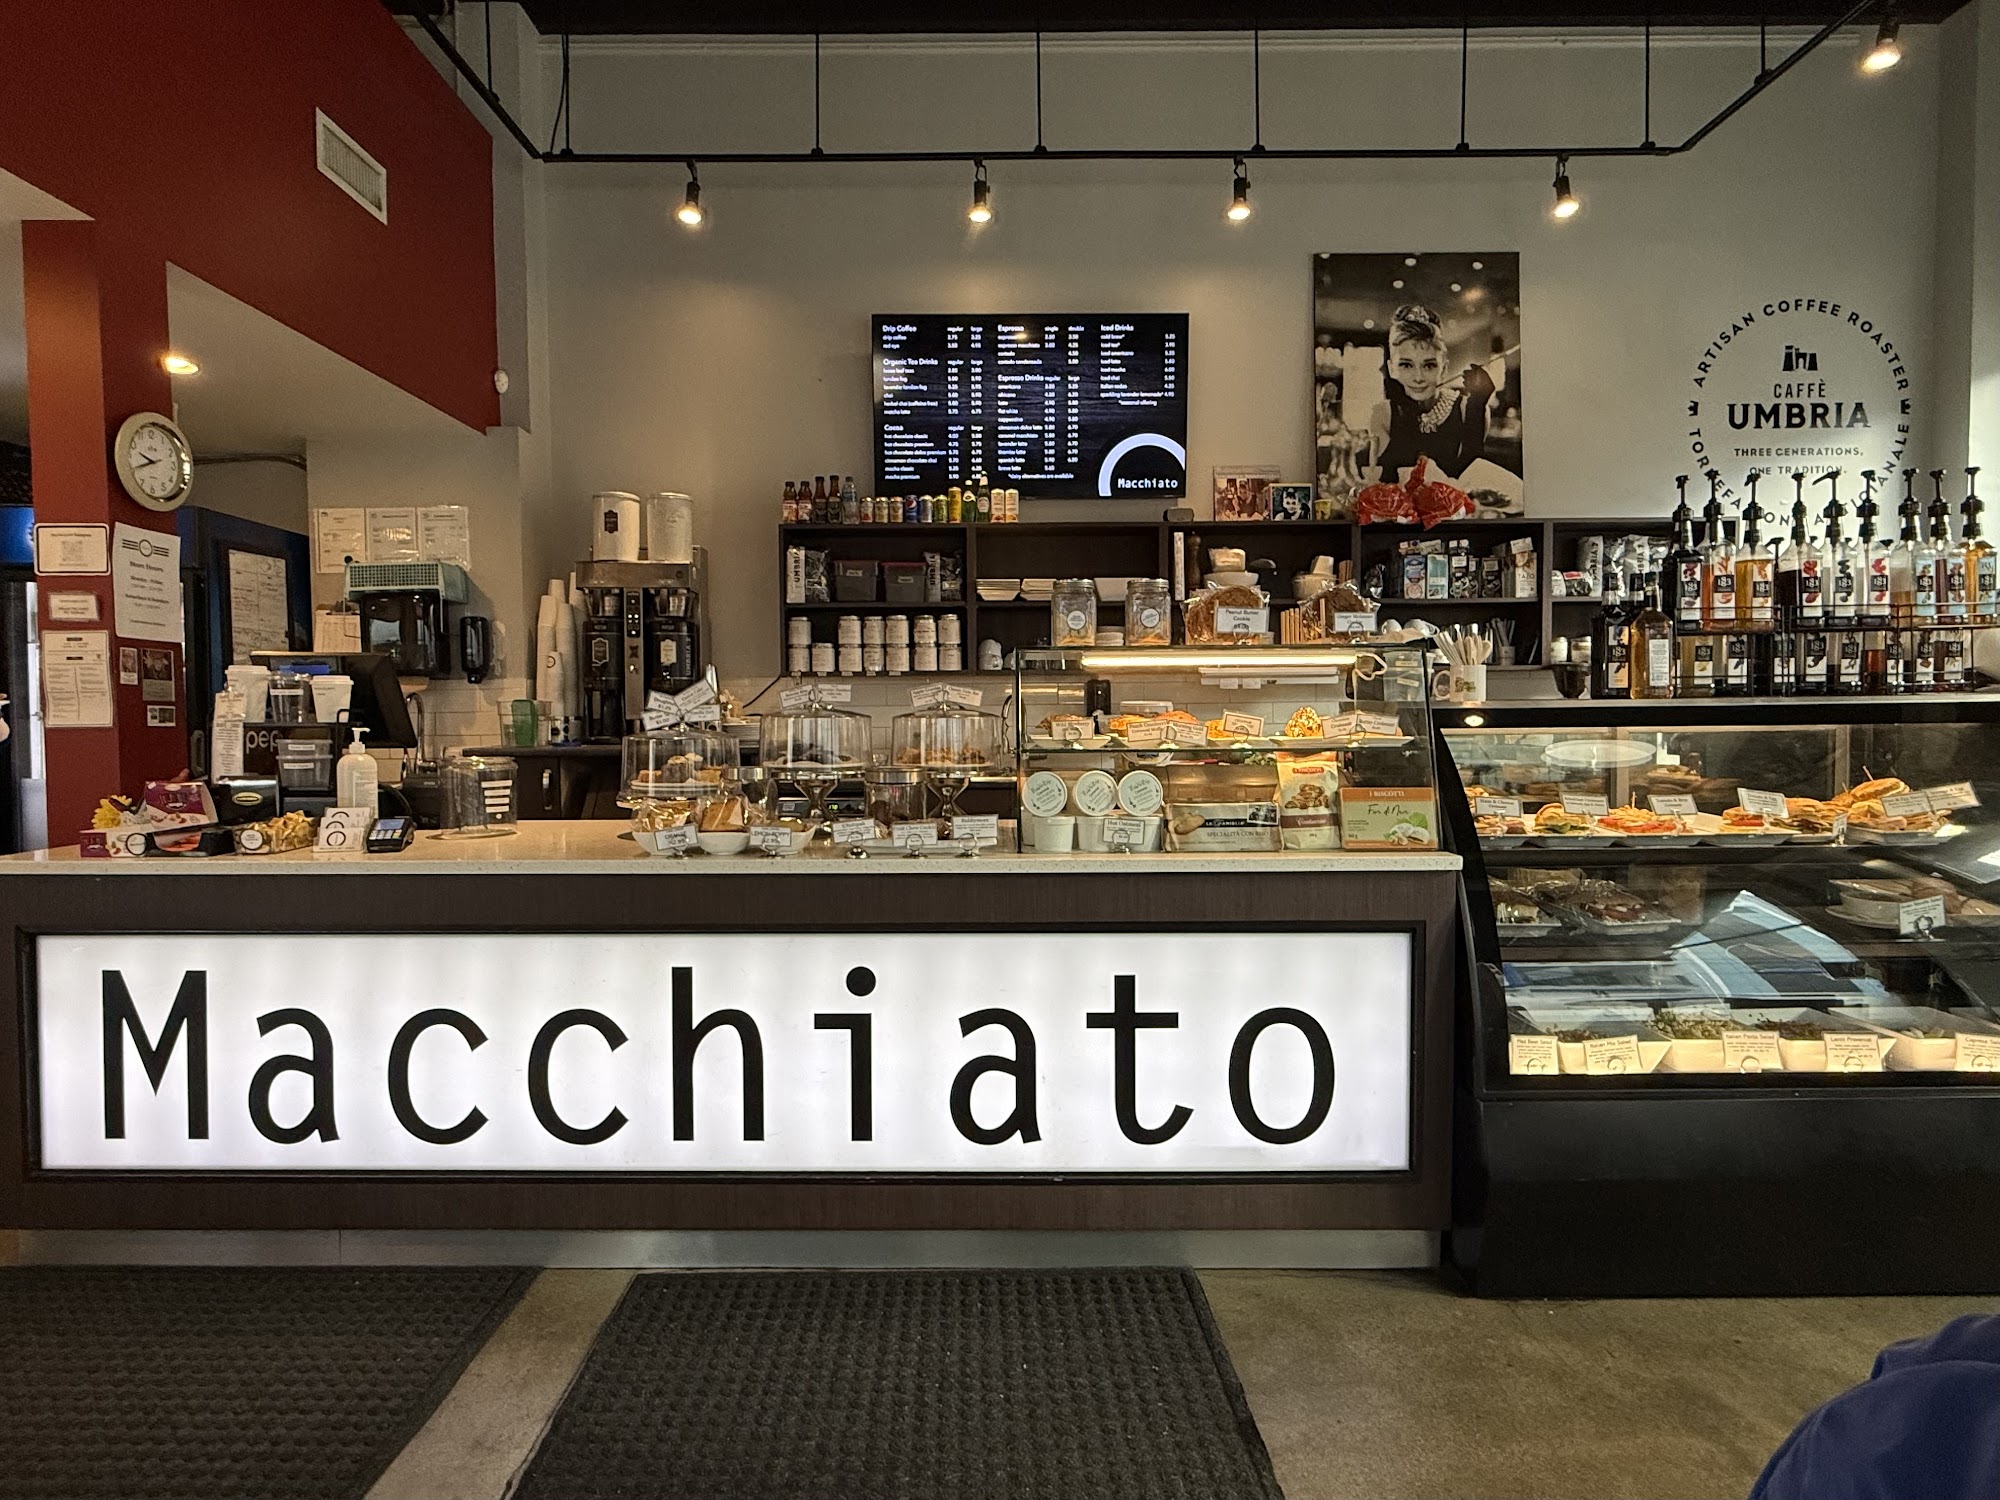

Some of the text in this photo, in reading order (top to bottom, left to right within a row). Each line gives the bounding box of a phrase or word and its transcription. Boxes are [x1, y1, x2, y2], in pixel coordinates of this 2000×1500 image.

[882, 324, 896, 333] Drip
[998, 324, 1024, 333] Espresso
[1694, 299, 1909, 391] ARTISAN COFFEE ROASTER
[883, 358, 907, 367] Organic
[998, 374, 1024, 382] Espresso
[1774, 378, 1826, 398] CAFFÈ
[1727, 402, 1871, 430] UMBRIA
[1734, 447, 1864, 457] THREE GENERATIONS,
[1750, 466, 1772, 475] ONE
[1118, 478, 1178, 488] Macchiato
[101, 966, 1335, 1145] Macchiato
